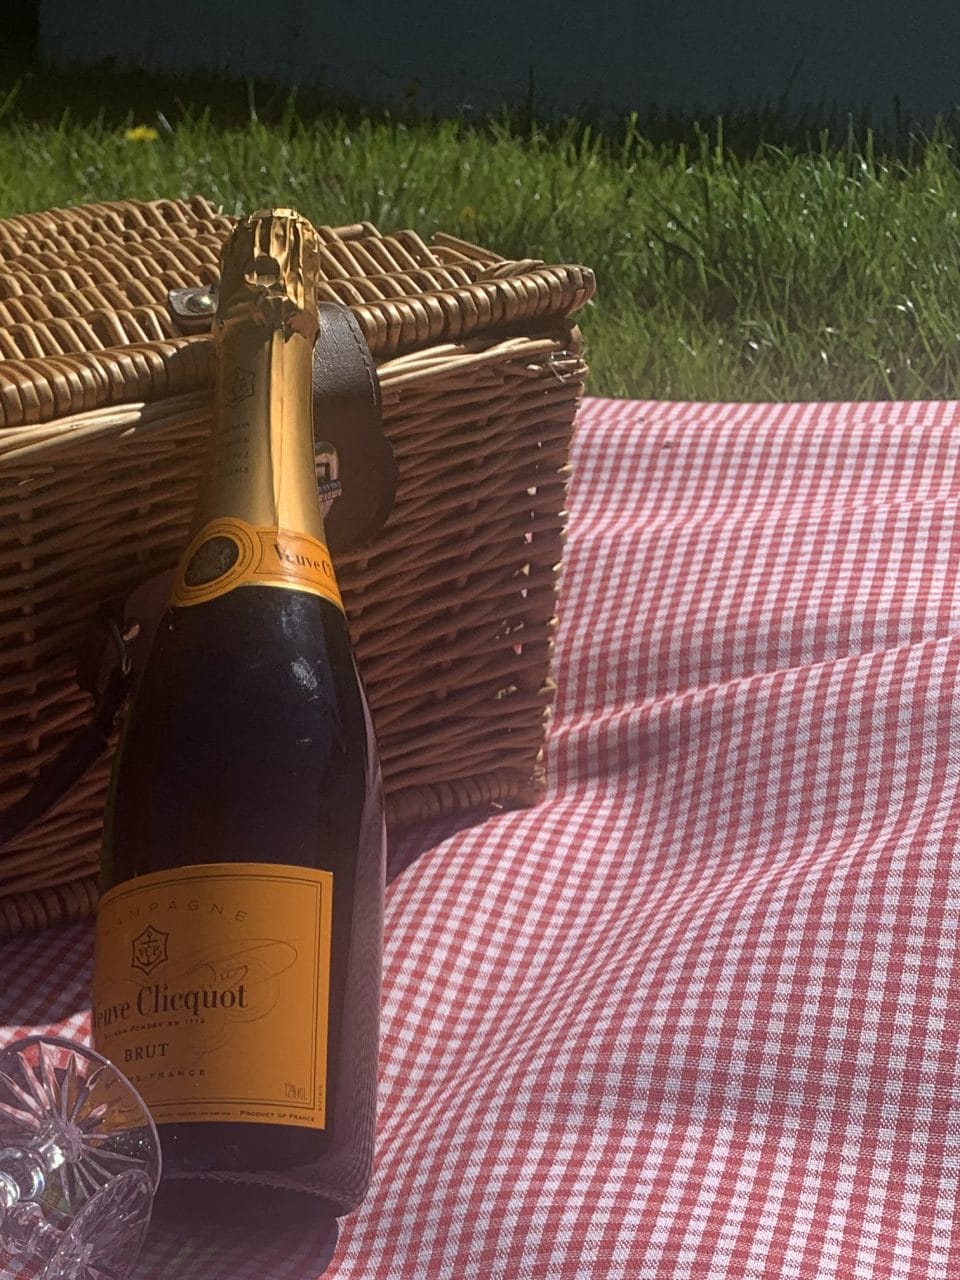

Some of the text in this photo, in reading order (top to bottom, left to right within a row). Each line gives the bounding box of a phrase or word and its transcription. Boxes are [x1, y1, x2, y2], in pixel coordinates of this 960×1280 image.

[274, 543, 320, 571] Veuve
[136, 984, 249, 1017] Clicquot
[124, 1043, 169, 1062] BRUT
[149, 1069, 206, 1079] FRANCE
